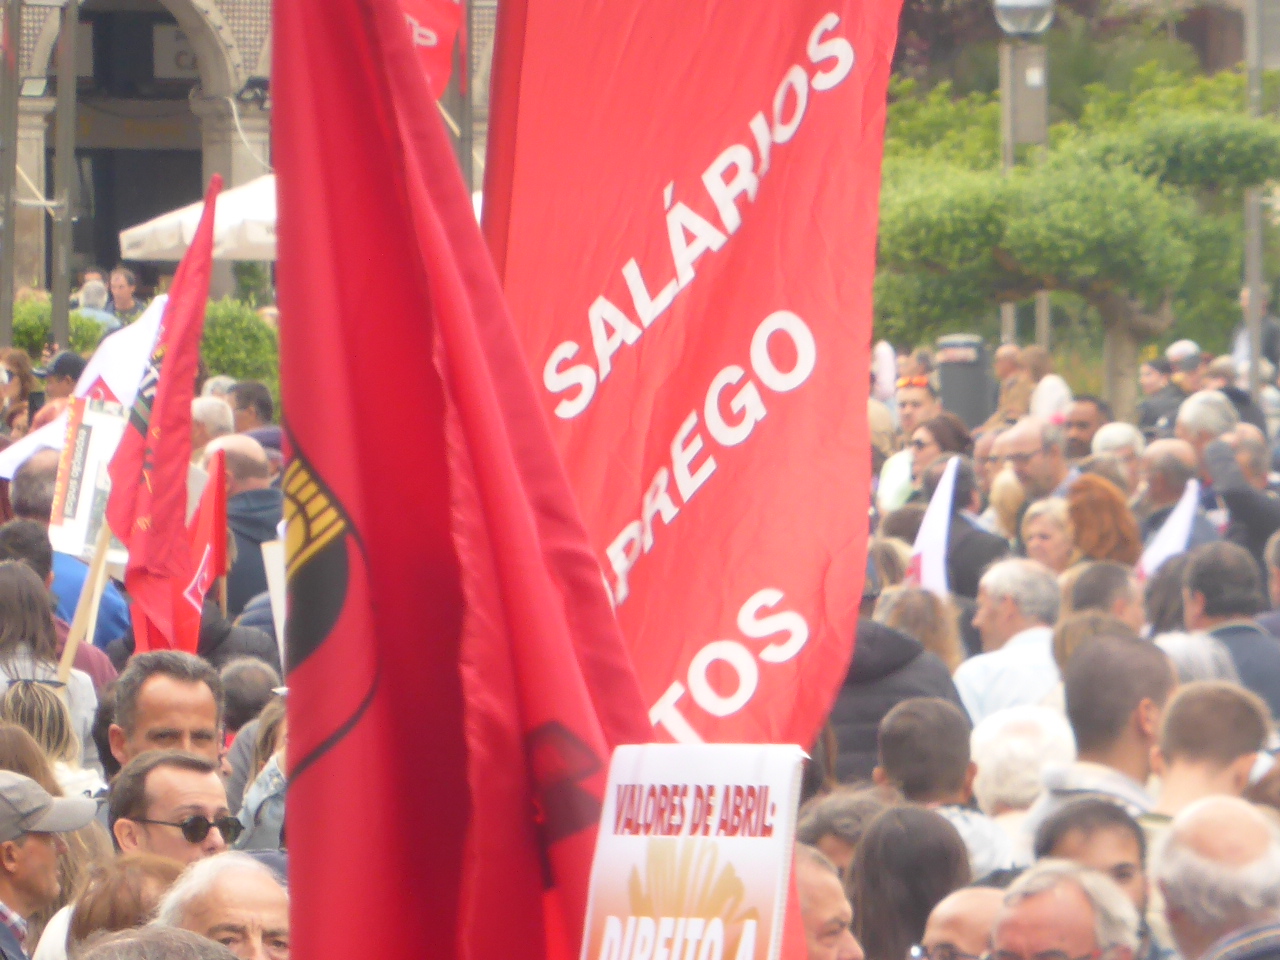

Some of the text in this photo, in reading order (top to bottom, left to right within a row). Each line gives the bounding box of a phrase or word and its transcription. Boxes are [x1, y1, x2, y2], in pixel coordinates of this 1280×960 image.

[543, 11, 855, 420] SALÁRIOS
[600, 309, 817, 612] PREGO
[648, 587, 810, 745] TOS
[613, 783, 777, 838] VALORES DE ABRIL:
